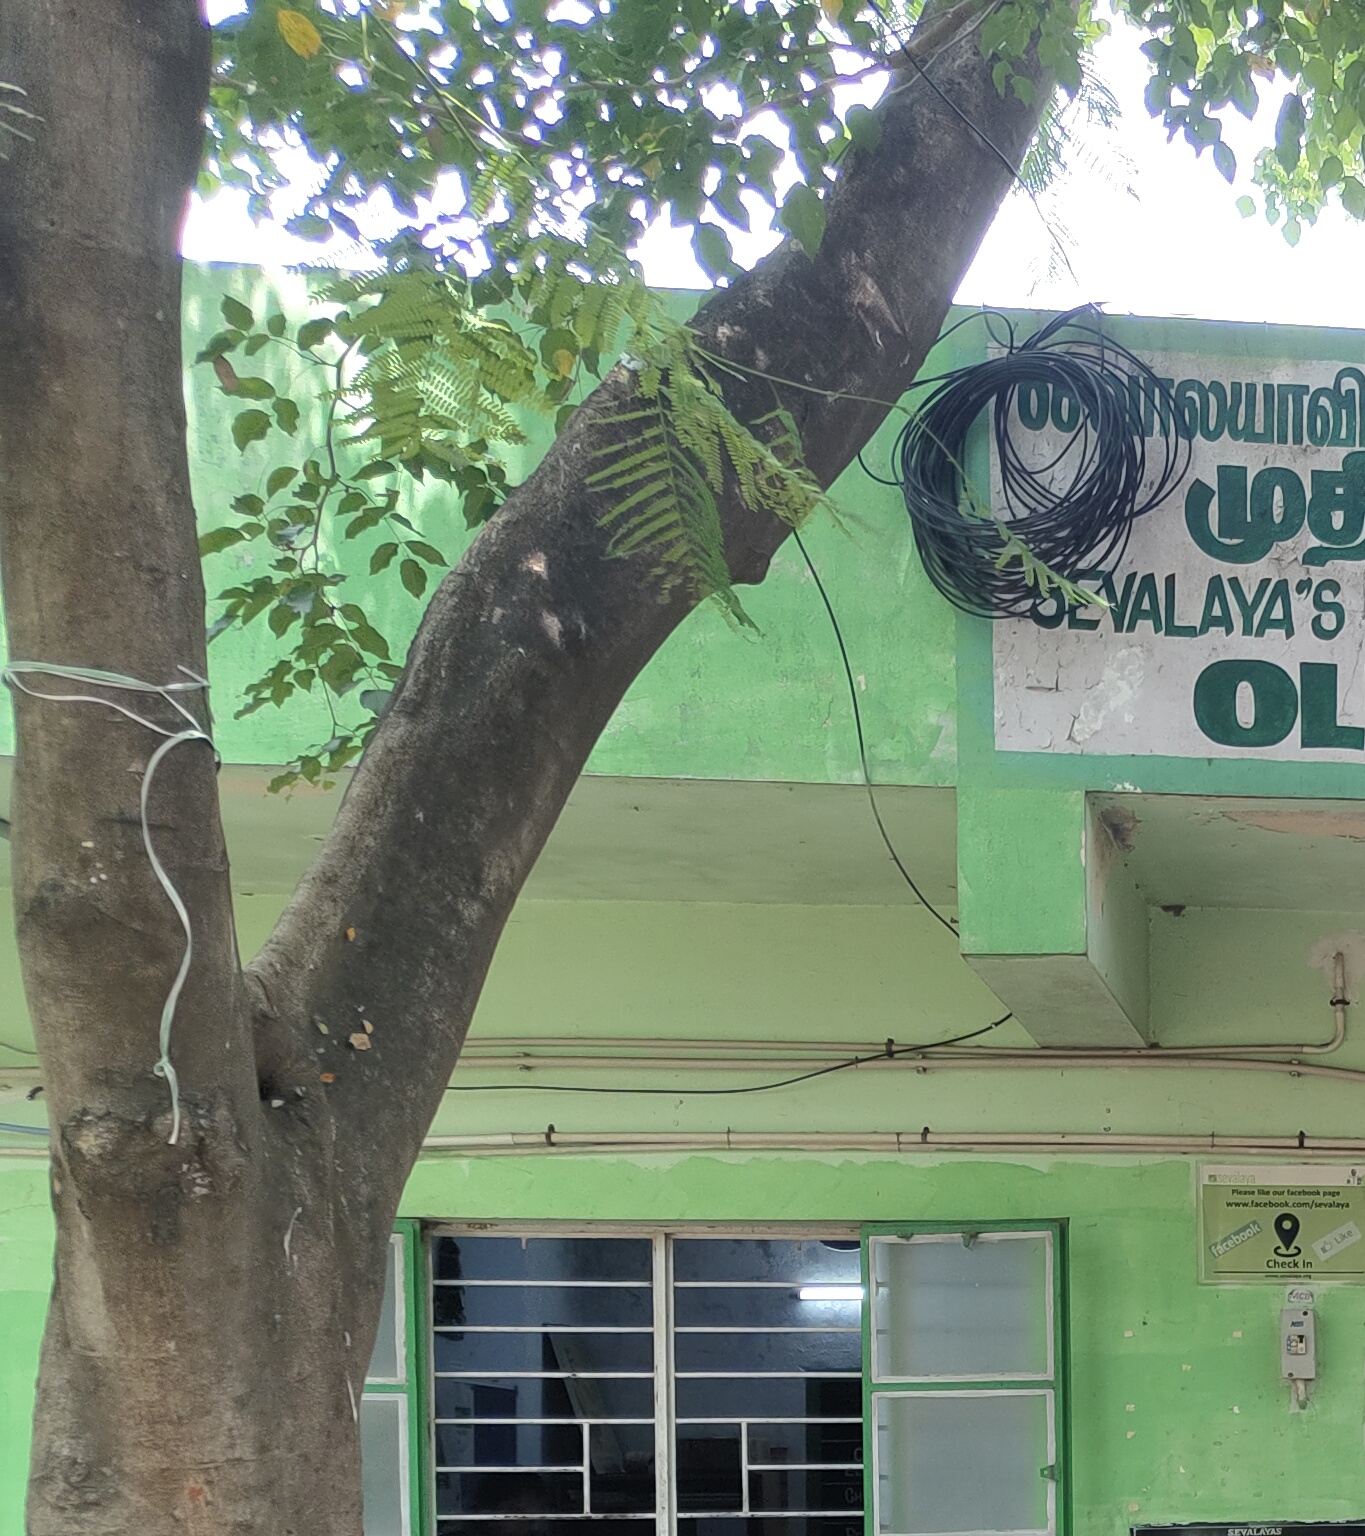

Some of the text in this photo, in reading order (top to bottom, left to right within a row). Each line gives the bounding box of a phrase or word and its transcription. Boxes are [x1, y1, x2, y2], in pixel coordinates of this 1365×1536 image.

[1217, 1172, 1256, 1185] sevalaya
[1231, 1188, 1256, 1197] Please
[1257, 1188, 1271, 1197] like
[1286, 1188, 1321, 1197] facebook
[1322, 1189, 1341, 1198] page
[1225, 1200, 1350, 1210] www.facebook.com/sevalaya
[1211, 1221, 1262, 1259] facebook
[1333, 1228, 1354, 1246] Like
[1266, 1259, 1313, 1269] Check In
[1227, 1528, 1283, 1536] SEVALAYAS
